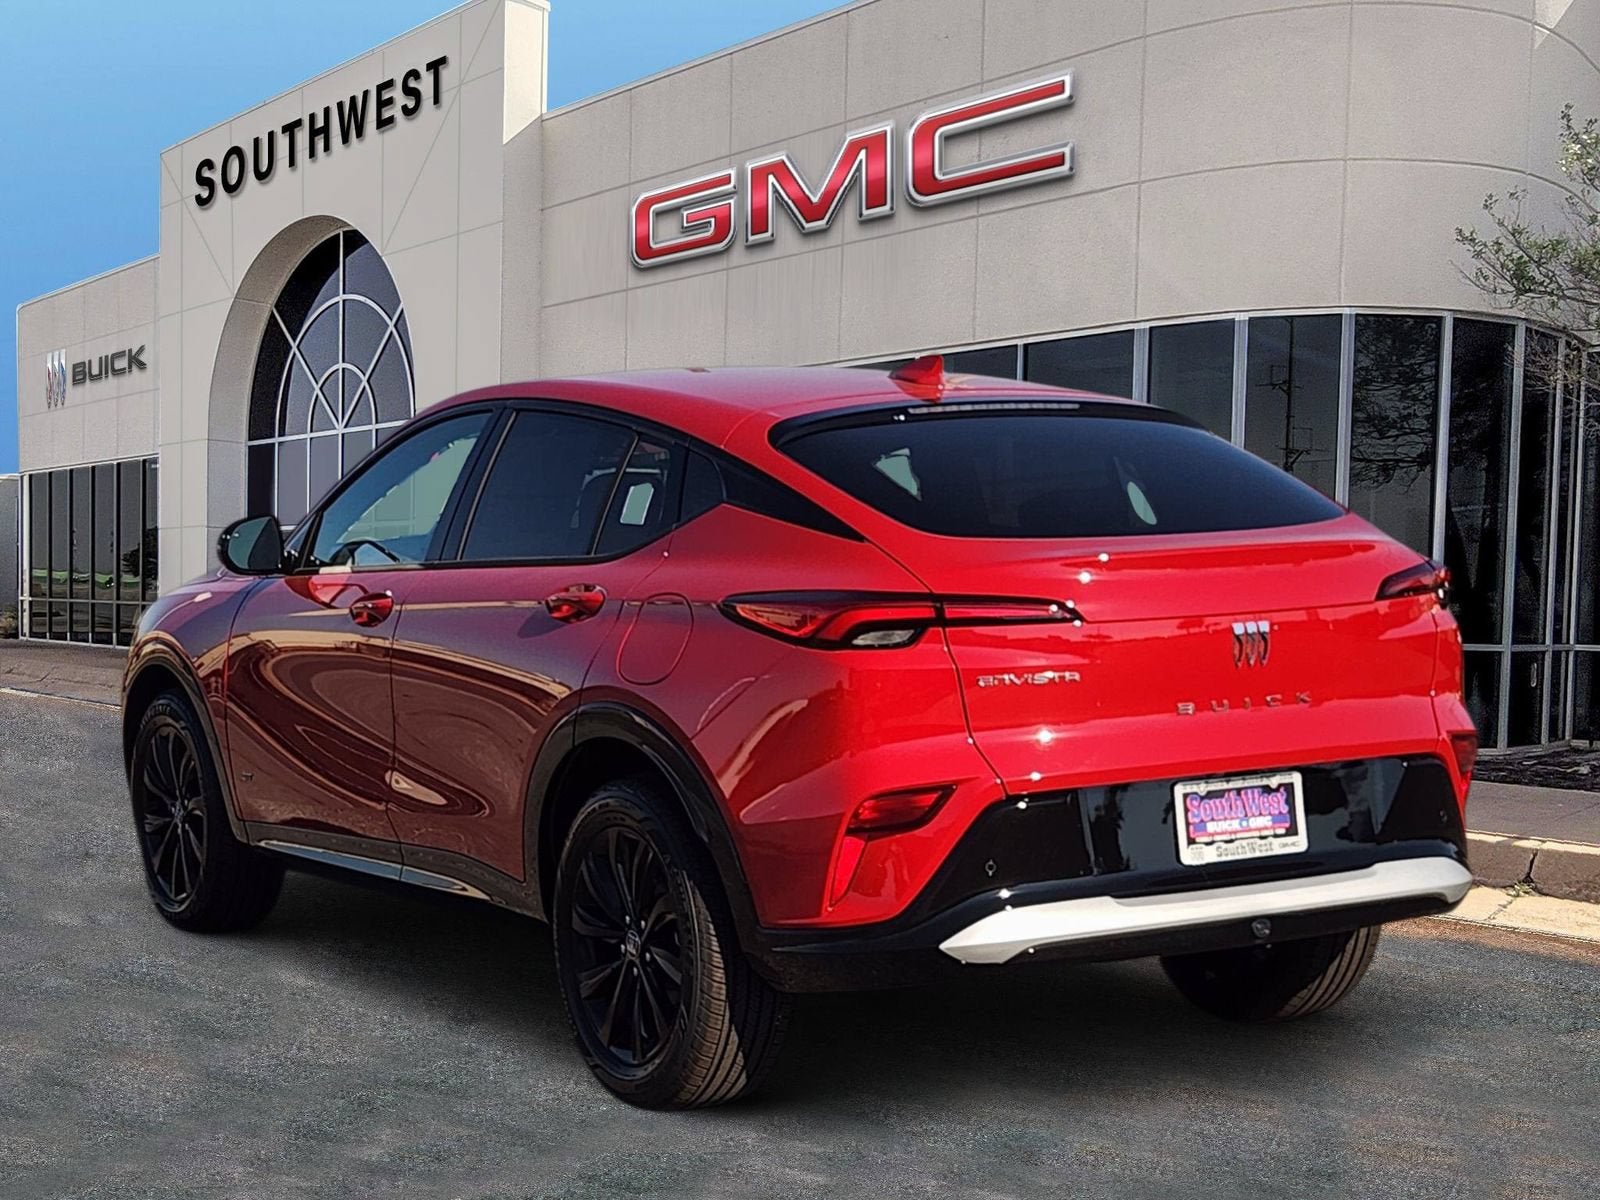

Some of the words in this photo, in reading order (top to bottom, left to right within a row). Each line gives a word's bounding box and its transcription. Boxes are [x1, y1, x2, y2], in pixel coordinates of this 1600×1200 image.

[194, 55, 448, 207] SOUTHWEST
[631, 69, 1075, 268] GMC
[72, 344, 147, 386] BUICK
[1176, 692, 1312, 716] BUICK
